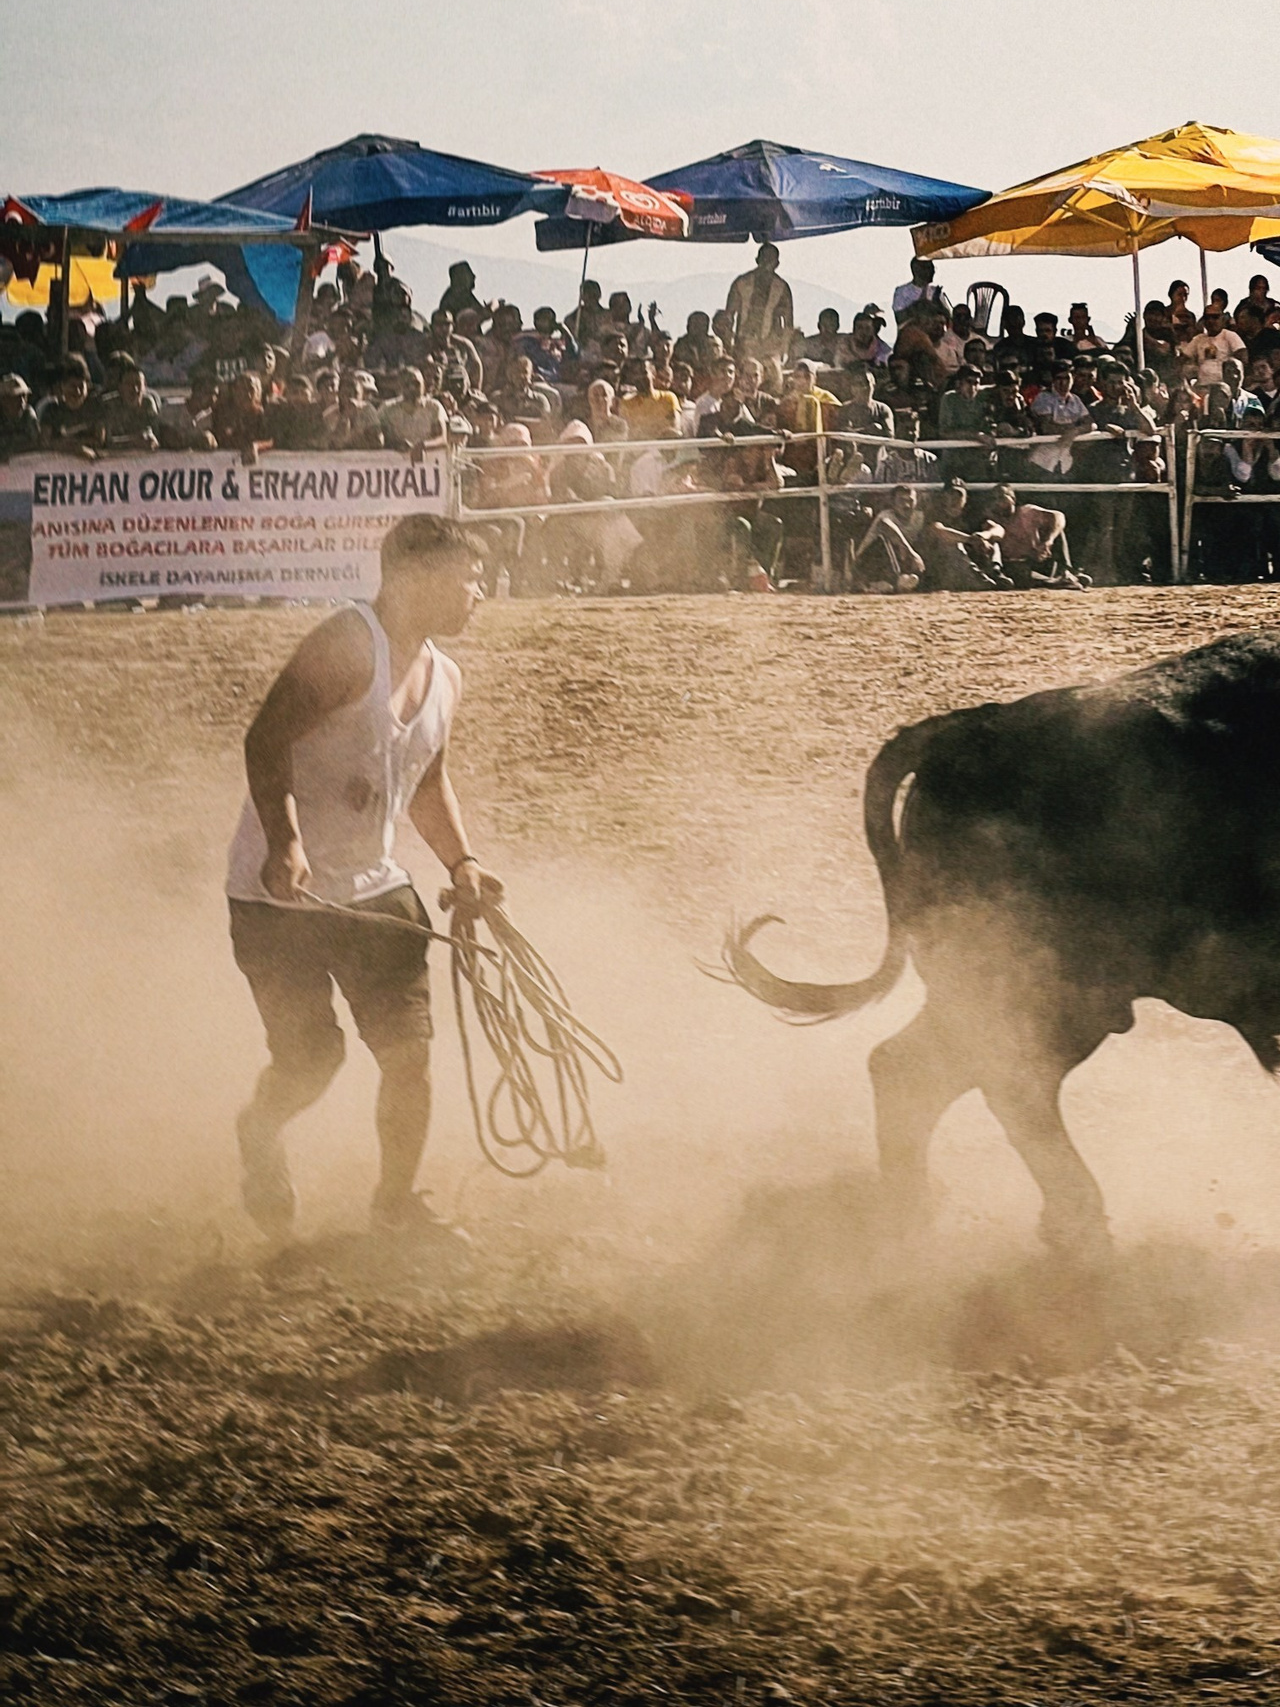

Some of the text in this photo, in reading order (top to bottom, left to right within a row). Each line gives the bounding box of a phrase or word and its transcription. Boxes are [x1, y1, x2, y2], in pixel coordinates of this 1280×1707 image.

[33, 471, 130, 507] ERHAN
[138, 468, 214, 503] OKUR
[221, 468, 240, 502] &
[248, 469, 339, 501] ERHAN
[33, 516, 116, 539] ANISINA
[122, 512, 255, 533] DÜZENLENEN
[49, 539, 90, 560] TÜM
[233, 537, 336, 557] BAŞARILAR
[342, 534, 382, 552] DİLE
